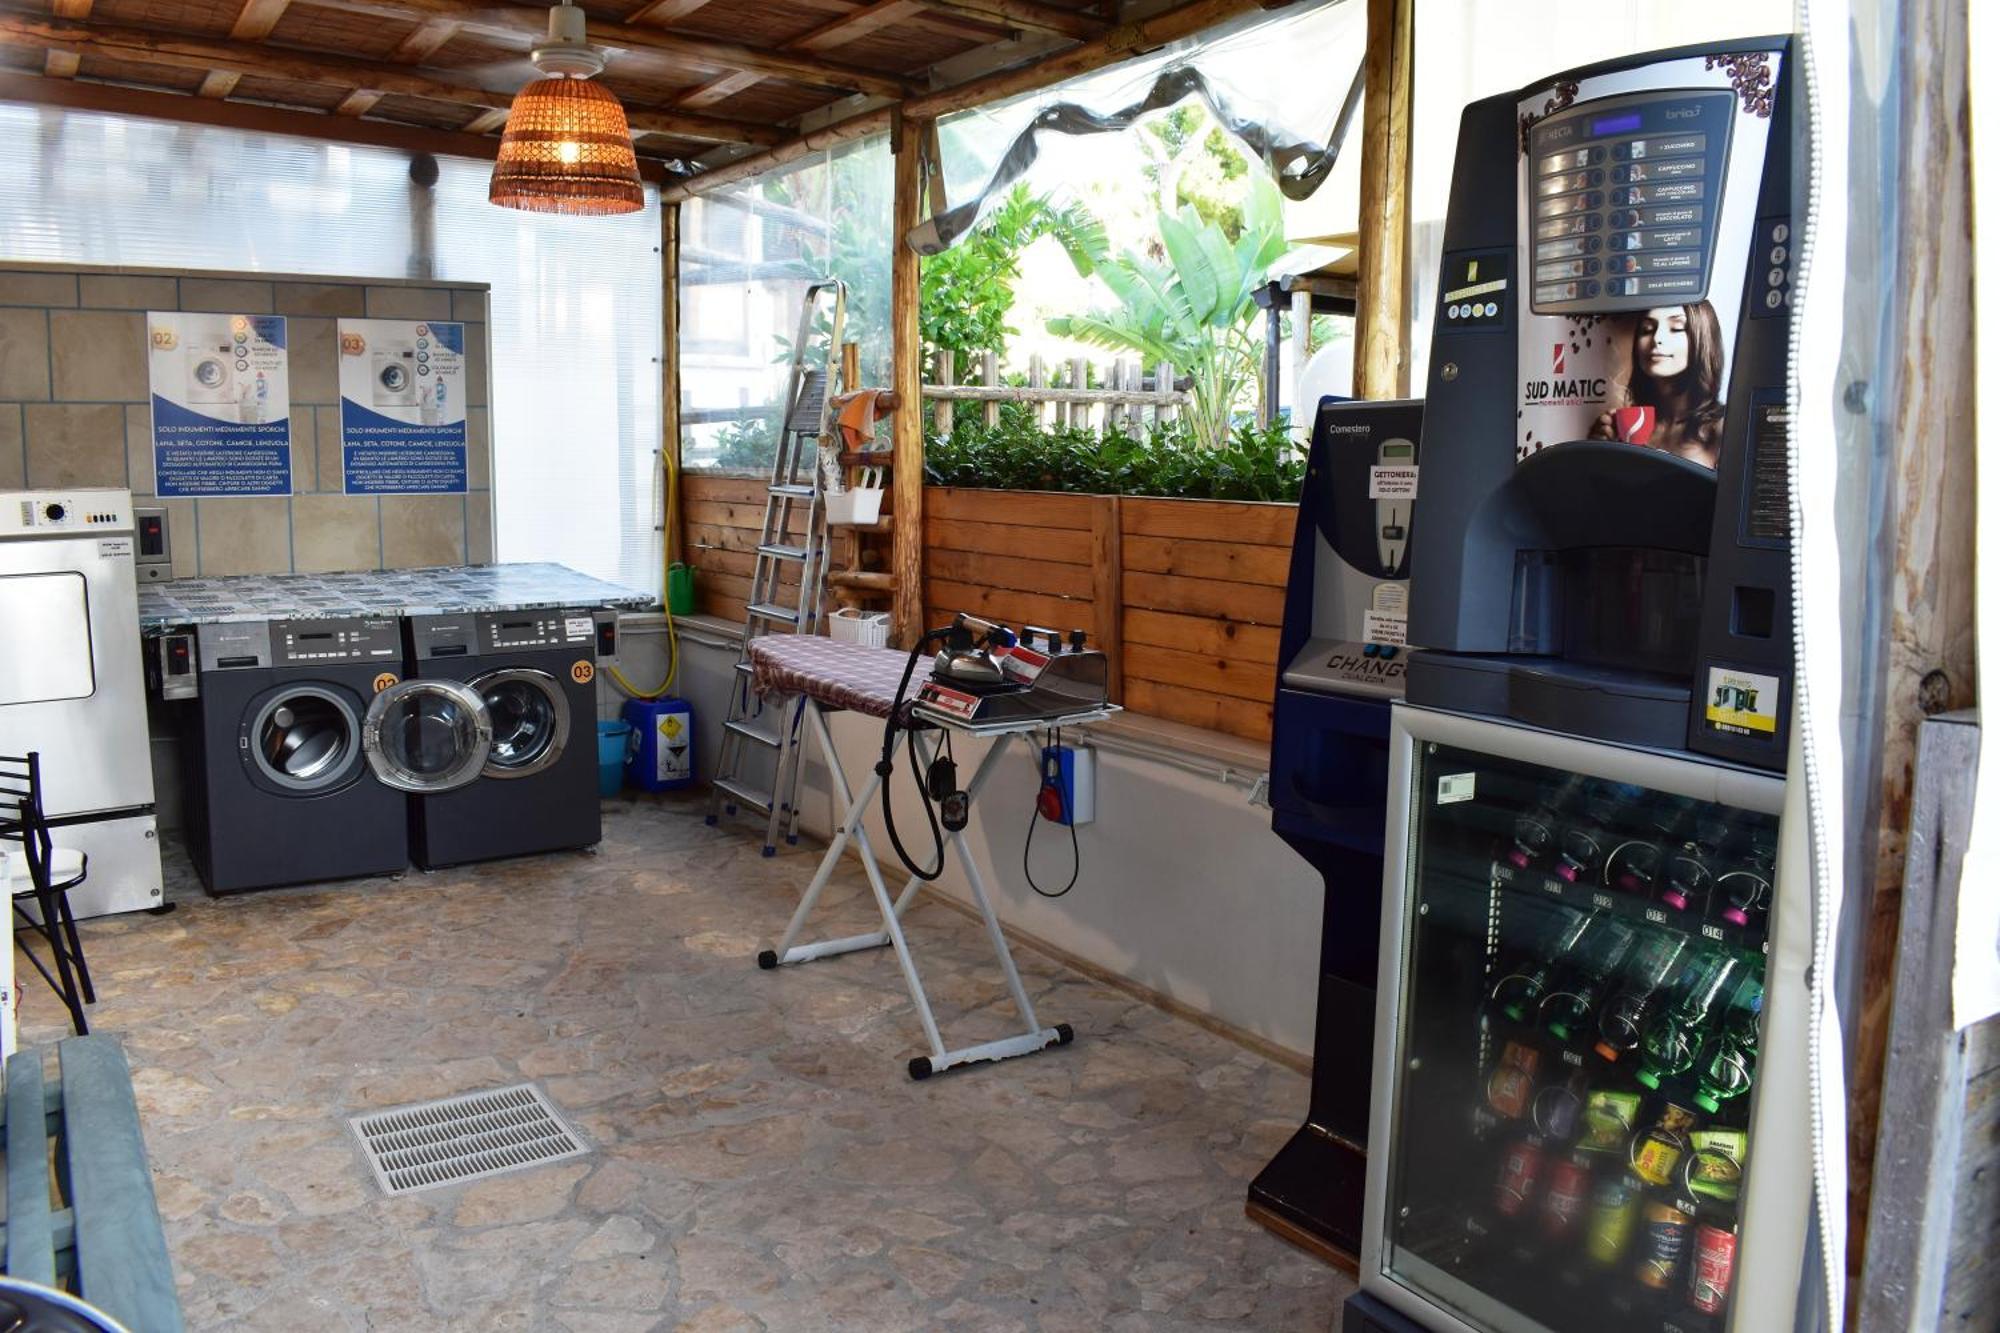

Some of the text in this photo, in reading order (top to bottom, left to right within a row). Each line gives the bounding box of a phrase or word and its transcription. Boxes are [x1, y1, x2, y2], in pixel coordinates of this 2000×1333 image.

[1658, 164, 1696, 172] CAPPUCCINO
[154, 333, 172, 345] 02
[344, 340, 359, 350] 03
[1525, 378, 1606, 400] SUD MATIC
[1330, 424, 1370, 434] Comestero
[574, 665, 592, 678] 03
[1326, 655, 1408, 678] CHANG
[1646, 908, 1667, 923] 013
